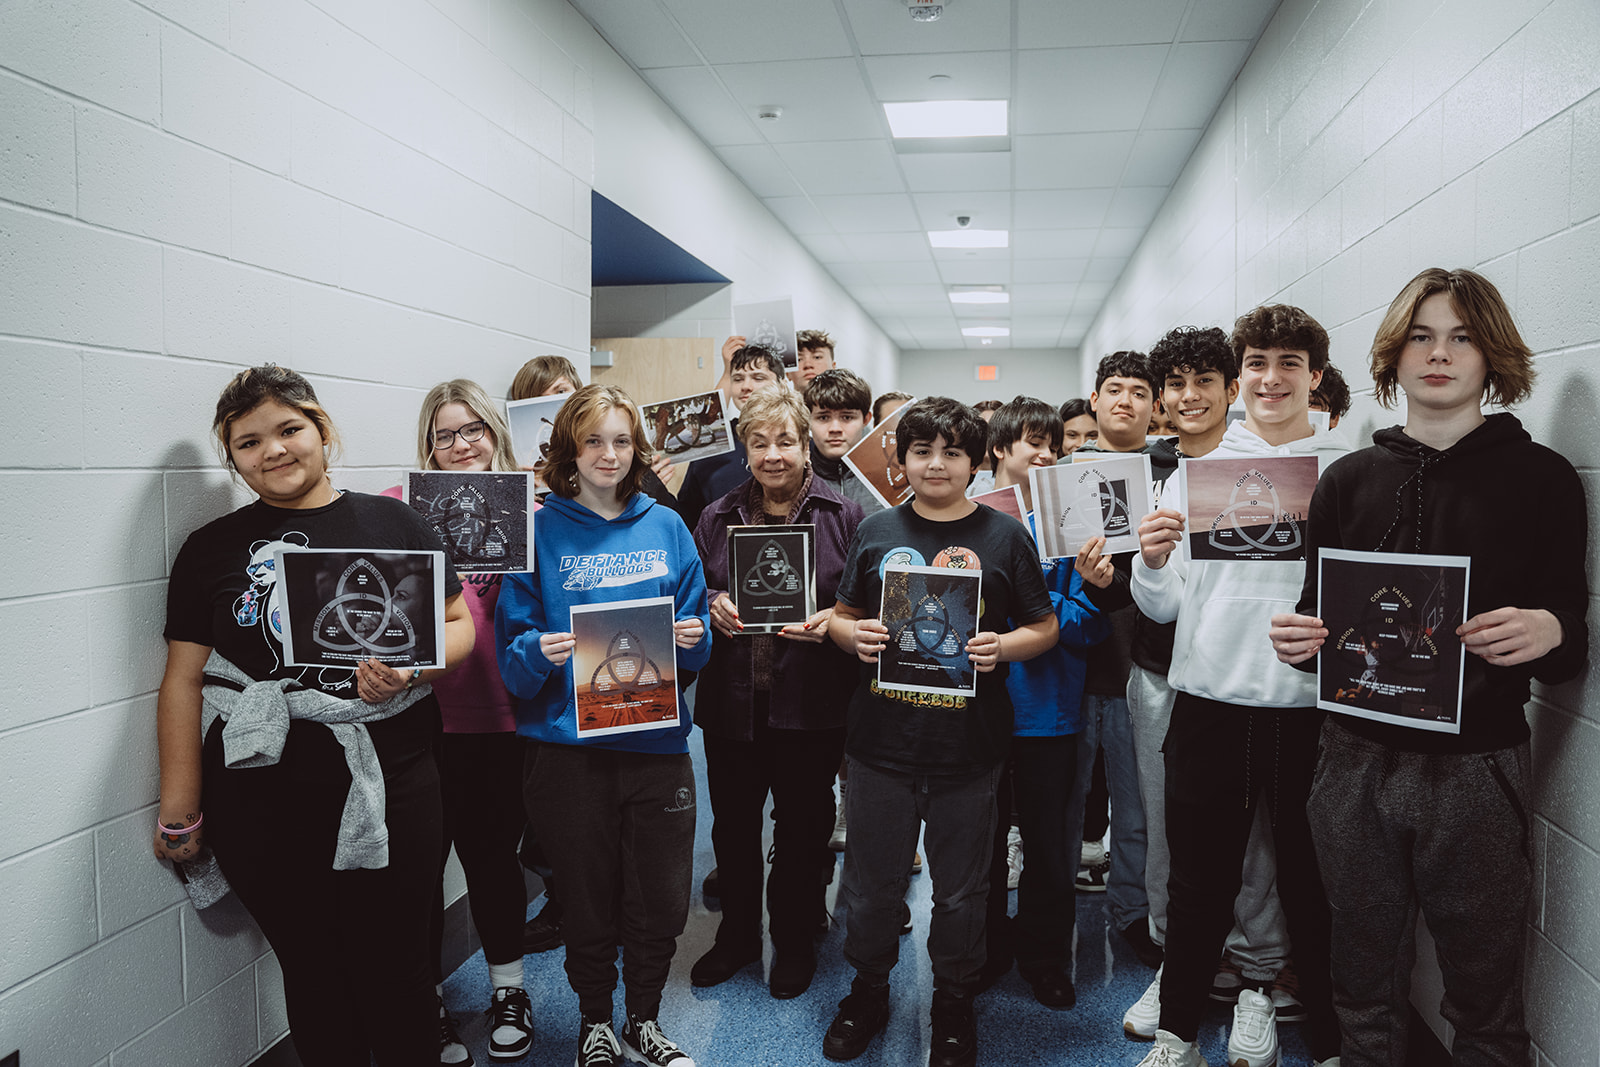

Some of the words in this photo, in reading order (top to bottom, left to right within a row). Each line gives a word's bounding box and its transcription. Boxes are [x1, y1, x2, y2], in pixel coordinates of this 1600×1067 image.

[1078, 470, 1090, 484] CORE
[1236, 472, 1250, 488] CORE
[1254, 470, 1273, 490] VALUES
[450, 485, 466, 500] CORE
[468, 484, 486, 504] VALUES
[1060, 506, 1072, 528] MISSION
[1209, 513, 1225, 537] MISSION
[1283, 512, 1298, 532] VISION
[494, 525, 508, 544] VISION
[344, 562, 359, 578] CORE
[363, 560, 384, 583] VALUES
[559, 550, 668, 572] DEFIANCE
[586, 562, 653, 578] BULLDOGS
[918, 594, 930, 606] CORE
[932, 593, 946, 610] VALUES
[1370, 586, 1388, 603] CORE
[1392, 586, 1413, 609] VALUES
[314, 606, 330, 632] MISSION
[395, 609, 412, 631] VISION
[1336, 627, 1355, 650] MISSION
[1422, 634, 1438, 656] VISION
